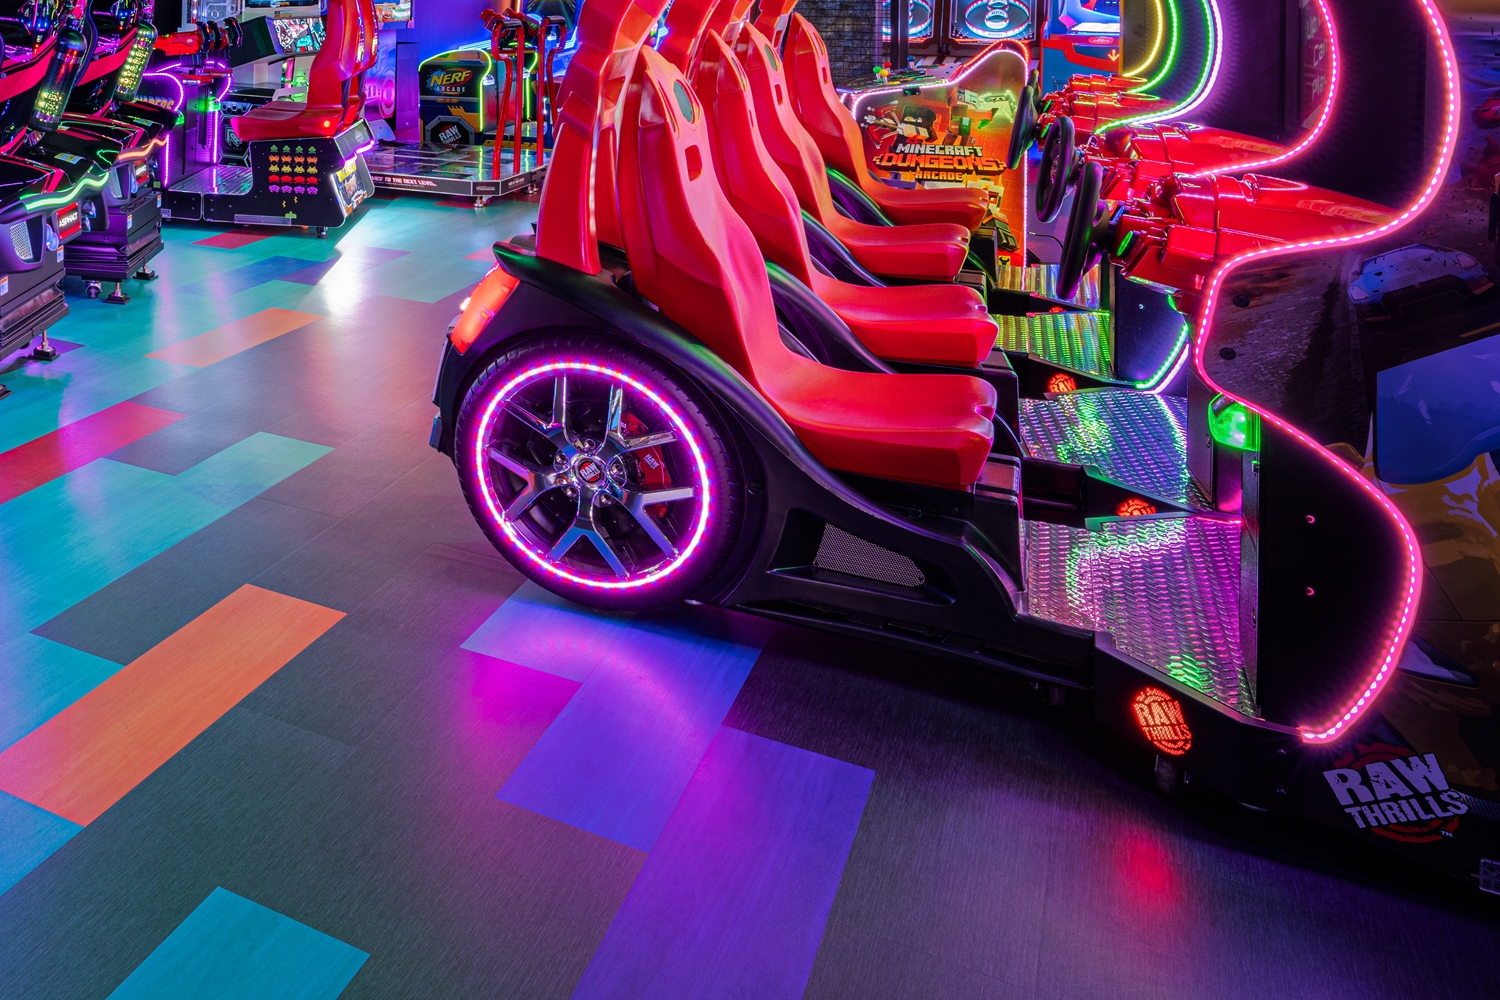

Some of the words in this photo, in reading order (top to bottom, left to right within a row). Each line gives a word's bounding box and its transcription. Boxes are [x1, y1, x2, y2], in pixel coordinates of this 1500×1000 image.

[429, 69, 472, 87] NERF
[438, 125, 459, 141] RAW
[895, 143, 982, 157] MINECRAFT
[880, 153, 1002, 172] DUNGEONS
[915, 170, 963, 181] ARCADE
[1134, 699, 1184, 727] RAW
[1142, 722, 1192, 743] THRILLS
[1323, 752, 1451, 806] RAW
[1344, 789, 1468, 829] THRILLS
